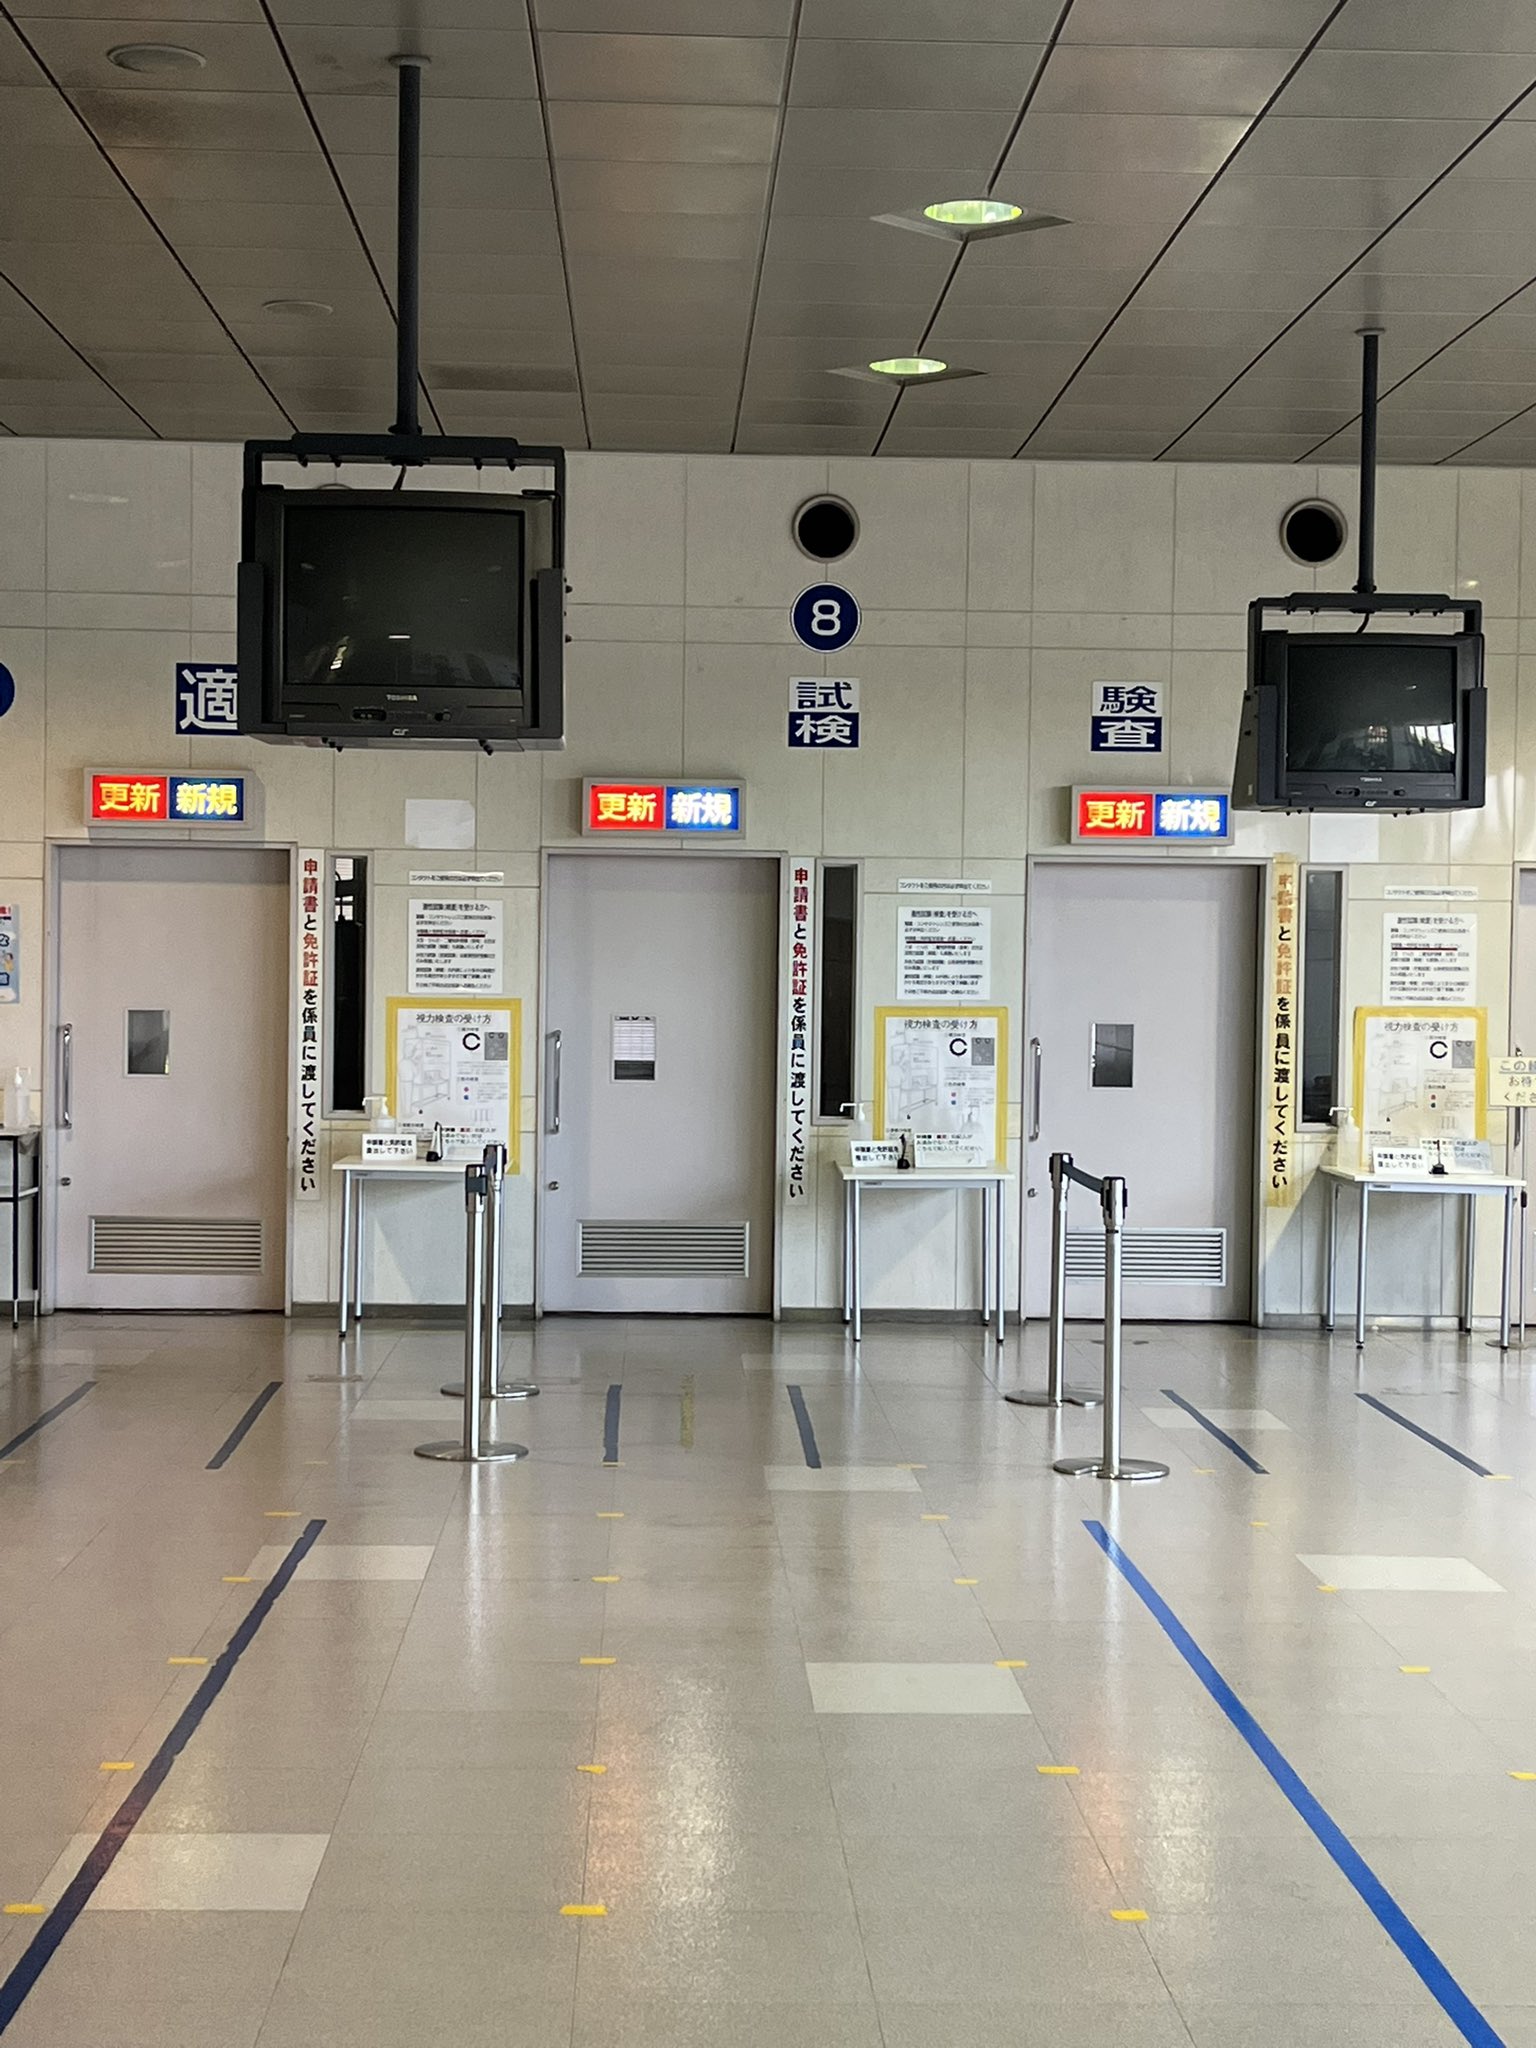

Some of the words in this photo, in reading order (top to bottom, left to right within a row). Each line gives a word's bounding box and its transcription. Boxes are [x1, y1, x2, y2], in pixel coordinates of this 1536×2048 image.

[811, 599, 841, 636] 8
[179, 669, 238, 730] 適
[796, 682, 853, 710] 試
[1099, 686, 1157, 714] 験
[795, 714, 853, 744] 検
[1099, 719, 1156, 748] 査
[99, 782, 161, 813] 更新
[175, 782, 238, 815] 新規
[597, 792, 657, 822] 更新
[671, 792, 732, 825] 新規
[1086, 800, 1146, 830] 更新
[1160, 799, 1221, 832] 新規
[300, 858, 319, 1191] 申請書と免許証を係員に渡してください
[416, 1013, 492, 1024] 視力検査の受け方
[789, 867, 808, 1198] 申請書と免許証を係員に渡してください
[904, 1019, 977, 1029] 視力検査の受け方
[1272, 874, 1293, 1189] 申請書と免許証を係員に渡してください
[1384, 1022, 1458, 1032] 視力検査の受け方
